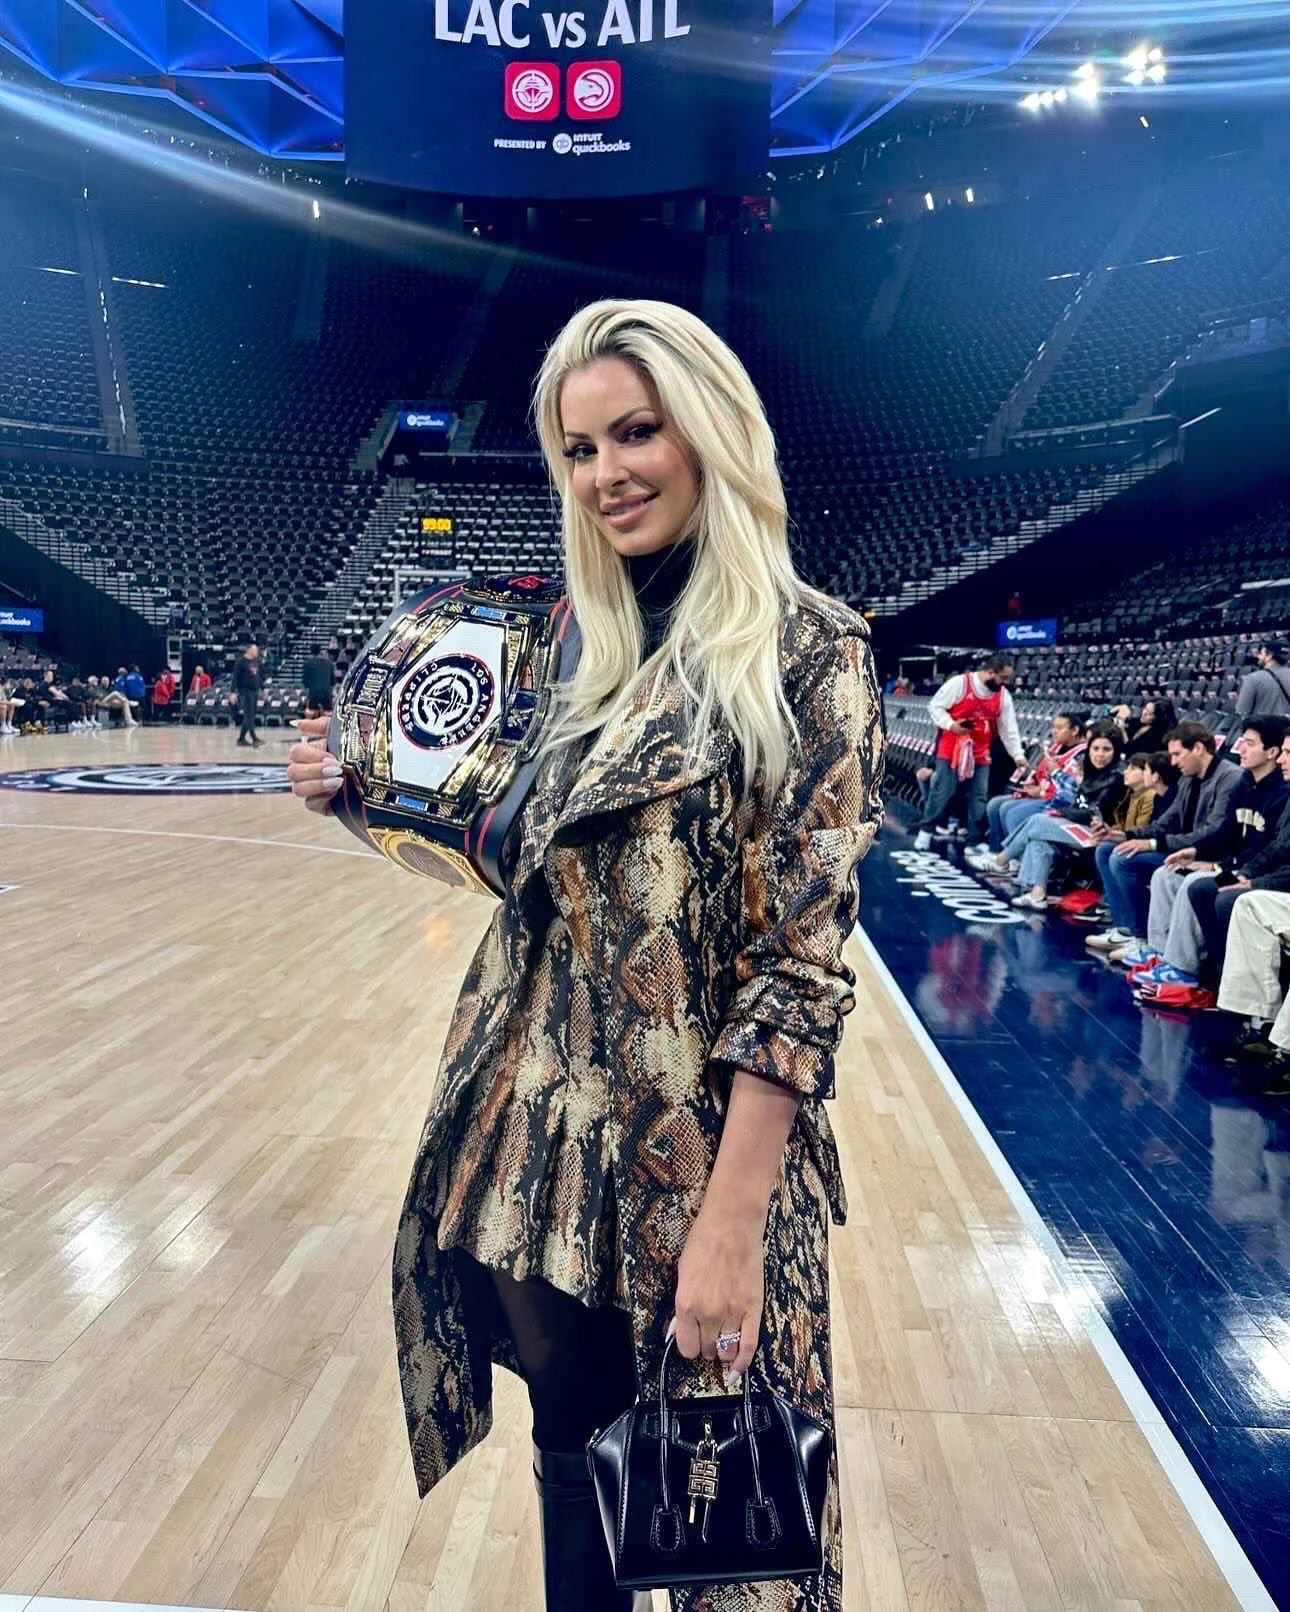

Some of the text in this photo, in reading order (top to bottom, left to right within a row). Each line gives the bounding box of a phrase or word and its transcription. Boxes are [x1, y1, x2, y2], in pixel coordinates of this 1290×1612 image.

[435, 0, 530, 48] LAC
[494, 138, 535, 149] PRESENTED
[536, 140, 546, 149] BY
[572, 139, 631, 156] quickbooks
[471, 662, 488, 685] LOS
[889, 850, 1025, 923] coinbase
